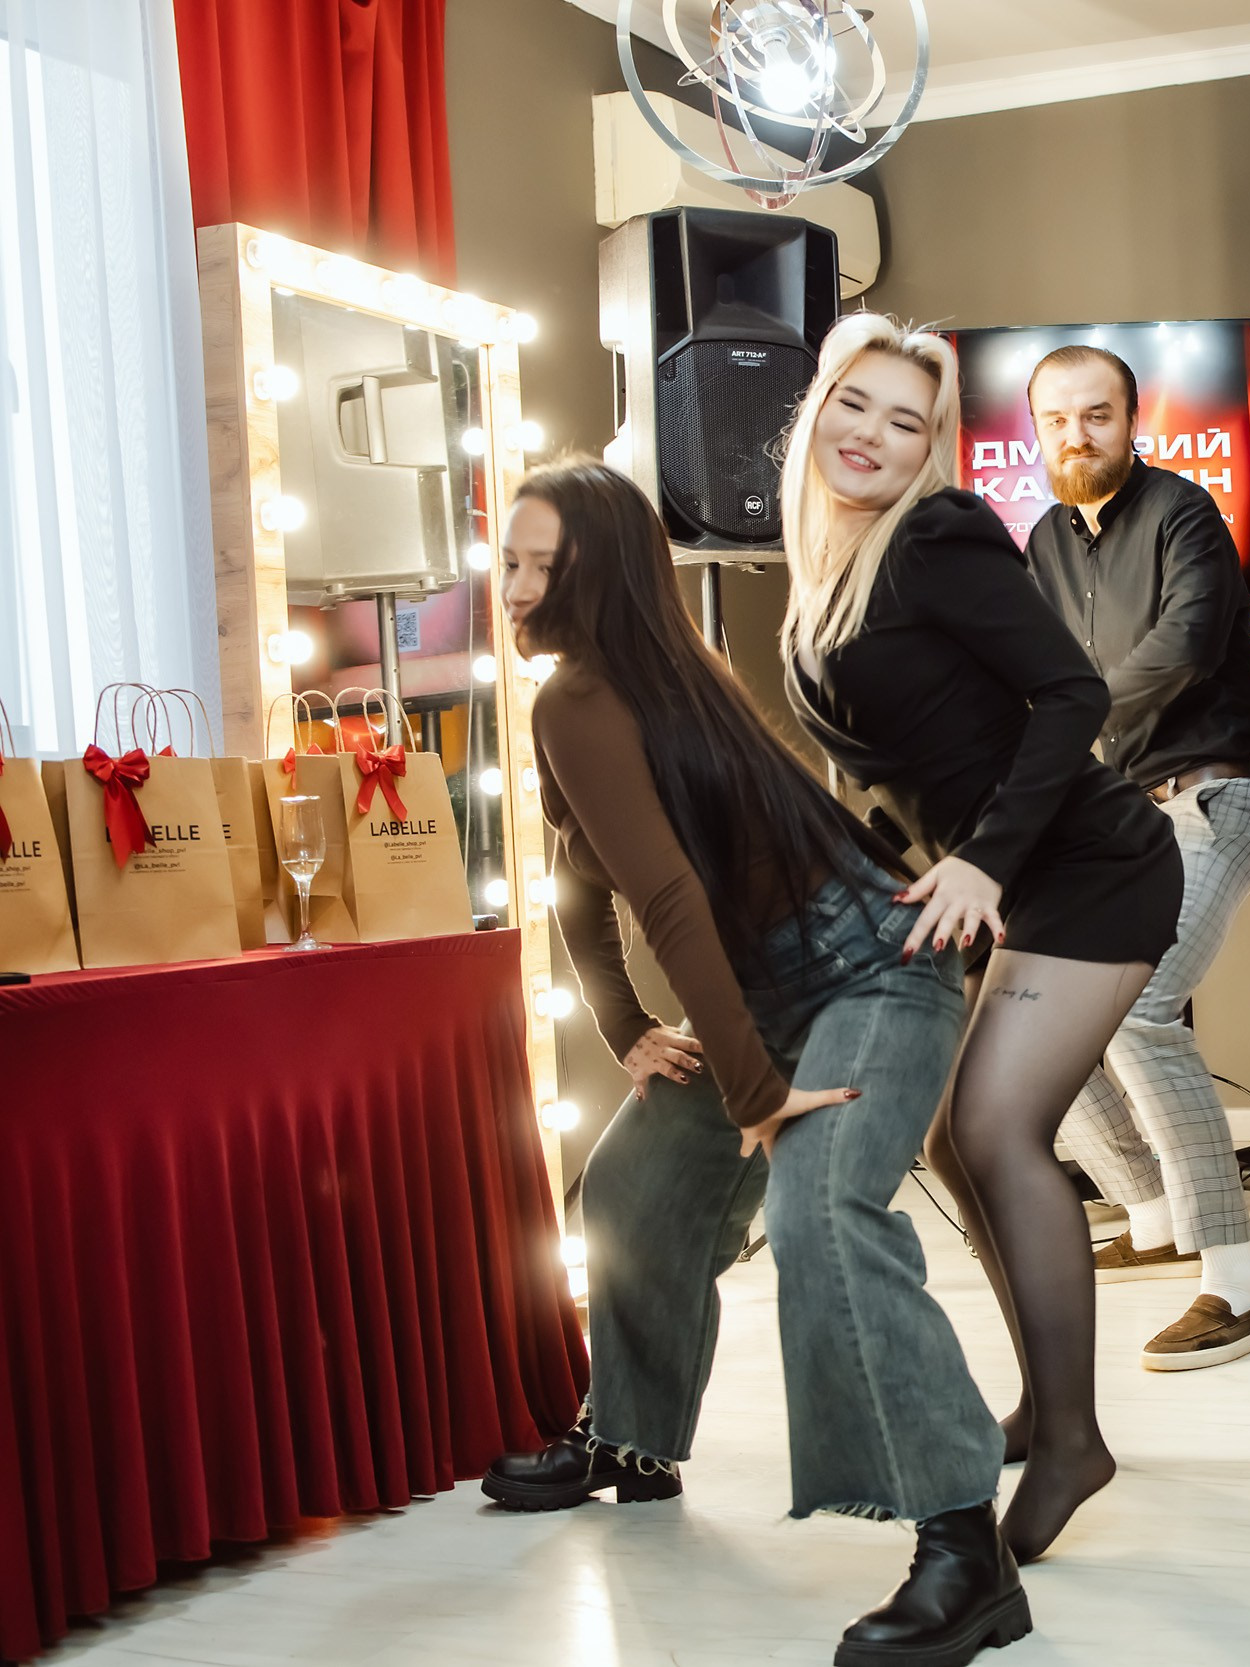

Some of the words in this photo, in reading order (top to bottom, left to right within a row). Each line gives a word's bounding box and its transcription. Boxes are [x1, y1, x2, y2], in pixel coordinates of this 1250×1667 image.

[972, 428, 1232, 470] ДМРИЙ
[747, 501, 761, 510] RCF
[370, 820, 437, 836] LABELLE
